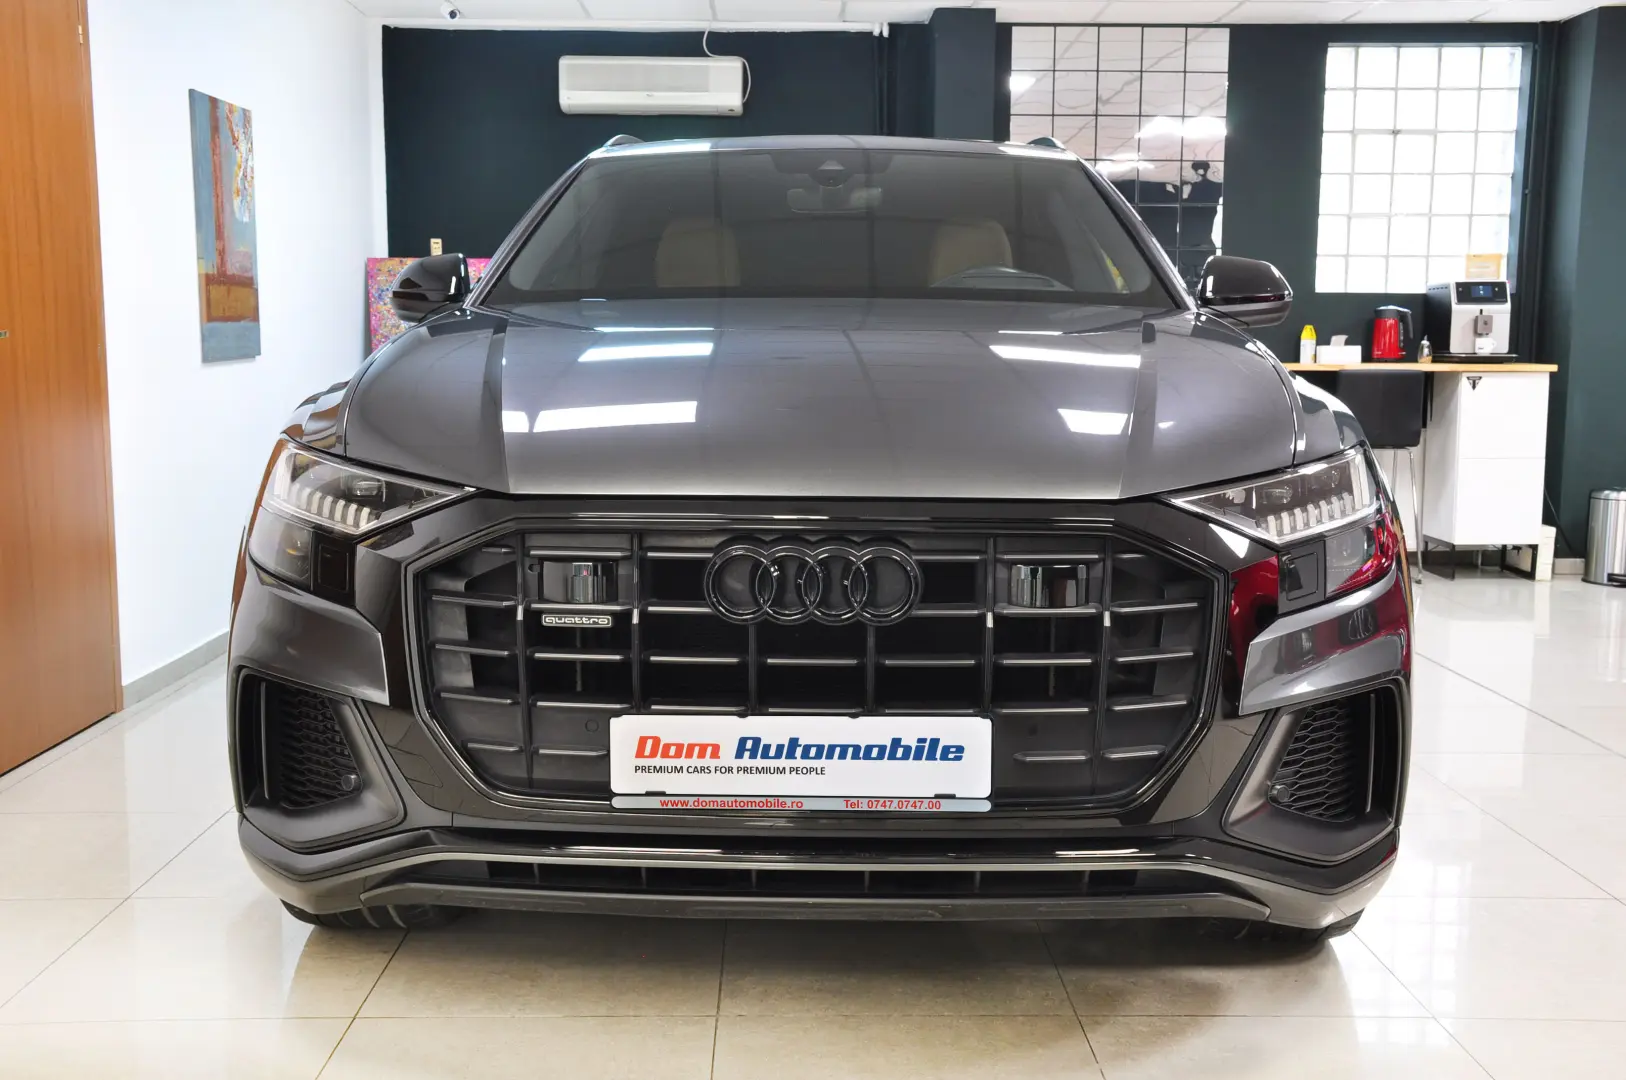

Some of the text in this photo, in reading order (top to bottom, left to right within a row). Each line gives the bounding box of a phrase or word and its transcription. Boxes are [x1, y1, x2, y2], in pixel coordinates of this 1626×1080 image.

[545, 616, 608, 624] quattro
[634, 735, 966, 762] Dom Automobile
[634, 765, 826, 776] PREMIUM CARS FOR PREMIUM PEOPLE
[659, 797, 804, 809] www.domautomobile.ro
[843, 799, 942, 810] Tel: 0747.0747.00
